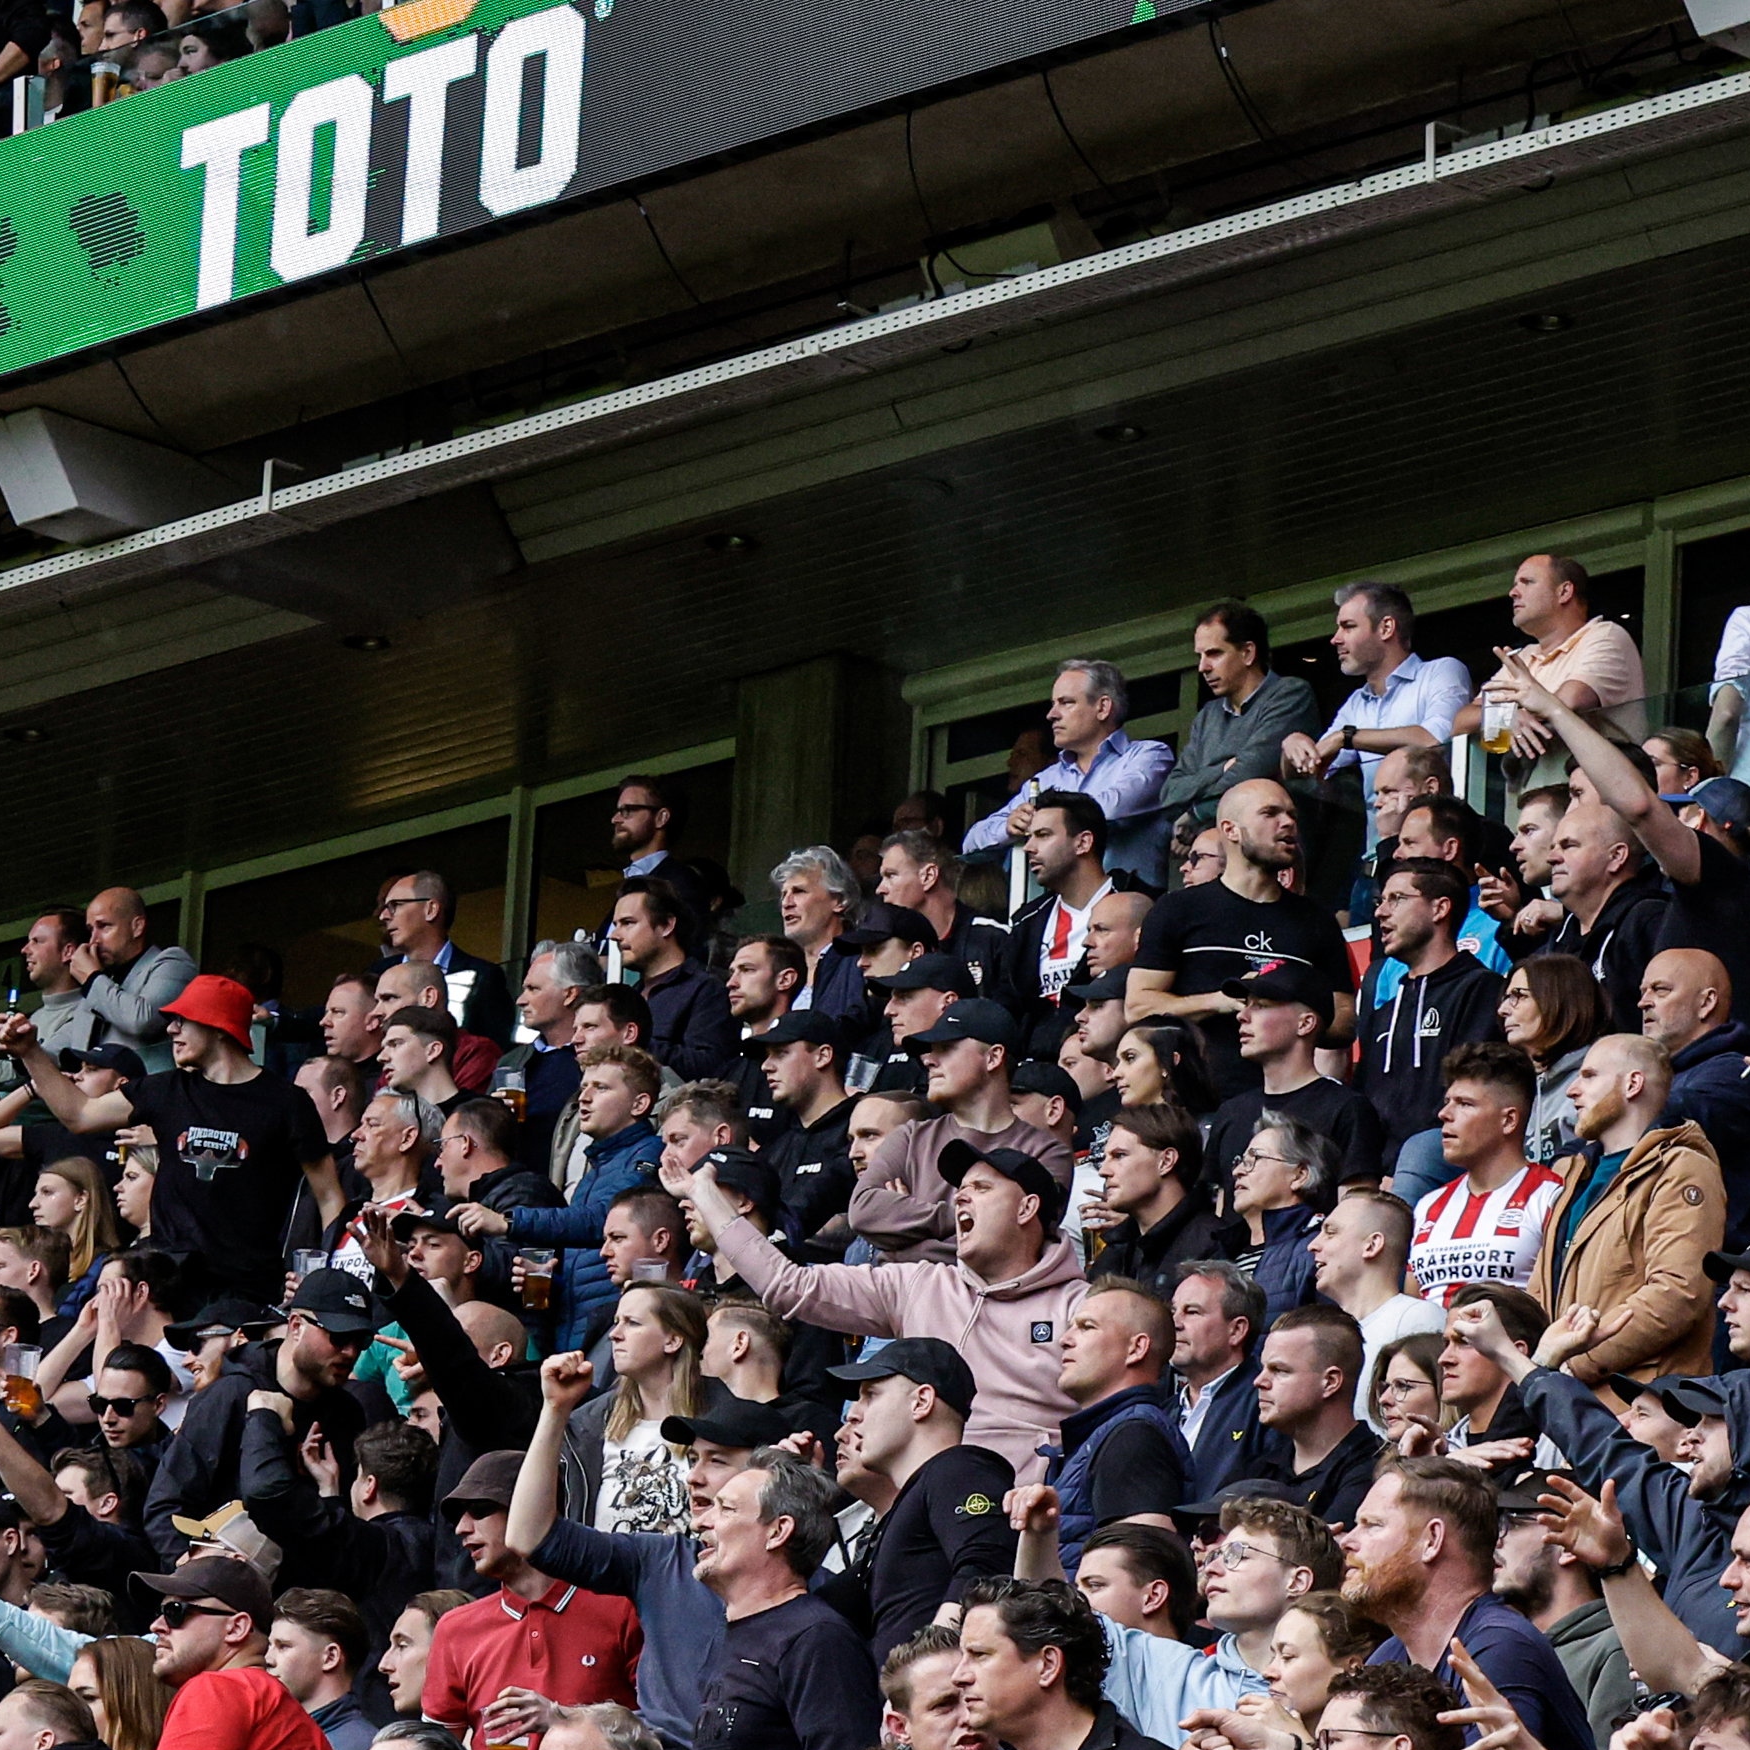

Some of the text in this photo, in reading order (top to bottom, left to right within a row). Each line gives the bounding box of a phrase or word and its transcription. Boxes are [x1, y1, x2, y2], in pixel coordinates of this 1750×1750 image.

[180, 3, 588, 310] TOTO
[1243, 929, 1272, 952] ck
[186, 1126, 239, 1150] EINDHOVEN
